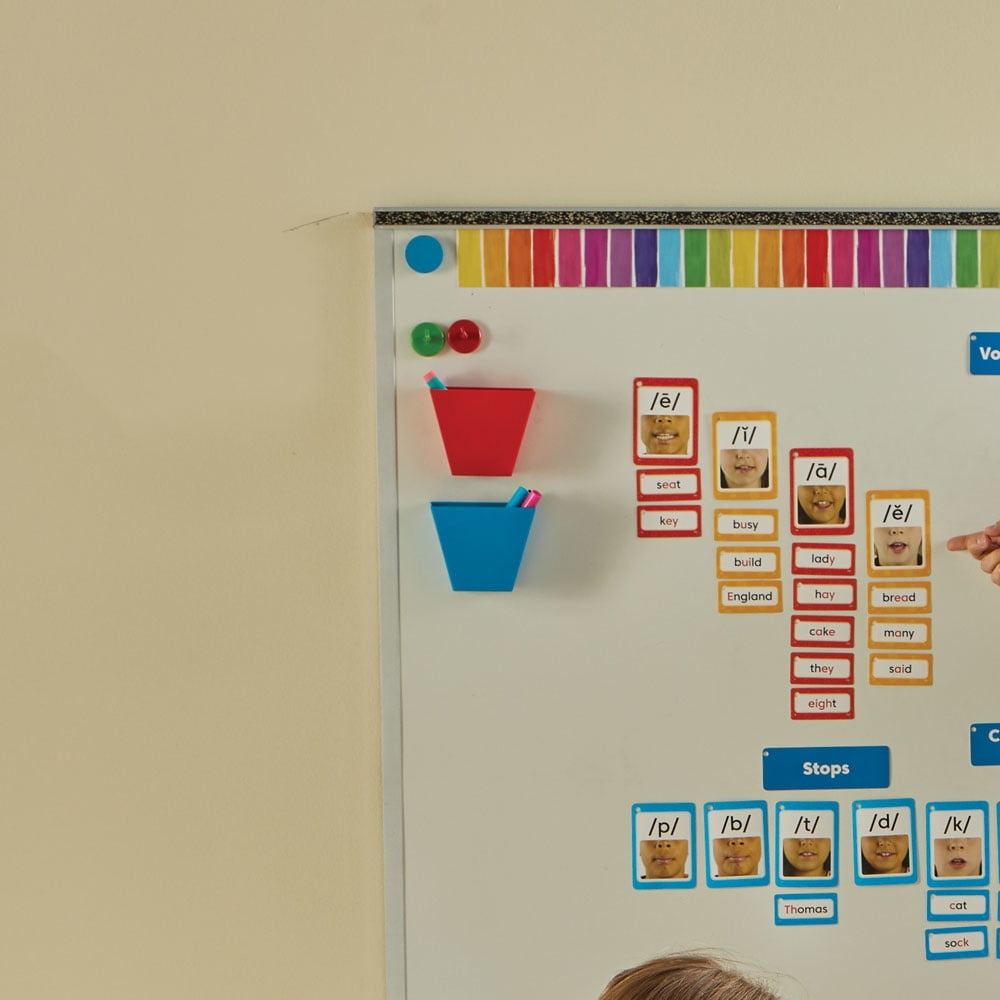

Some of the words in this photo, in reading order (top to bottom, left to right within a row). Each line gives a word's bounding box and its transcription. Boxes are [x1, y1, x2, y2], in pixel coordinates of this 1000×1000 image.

[656, 480, 681, 490] seat
[659, 515, 679, 528] key
[732, 519, 759, 532] busy
[734, 557, 762, 567] build
[811, 553, 836, 566] lady
[727, 591, 773, 604] England
[815, 589, 836, 602] hay
[882, 592, 916, 603] bread
[808, 626, 836, 637] cake
[883, 629, 915, 641] many
[809, 663, 834, 676] they
[888, 664, 912, 674] said
[807, 697, 838, 712] eight
[802, 761, 850, 779] Stops
[649, 818, 679, 837] /p/
[721, 815, 751, 834] /b/
[795, 816, 819, 834] /t/
[870, 813, 899, 832] /d/
[944, 816, 971, 834] /k/
[784, 905, 828, 914] Thomas
[949, 901, 968, 910] cat
[944, 937, 970, 949] sock
